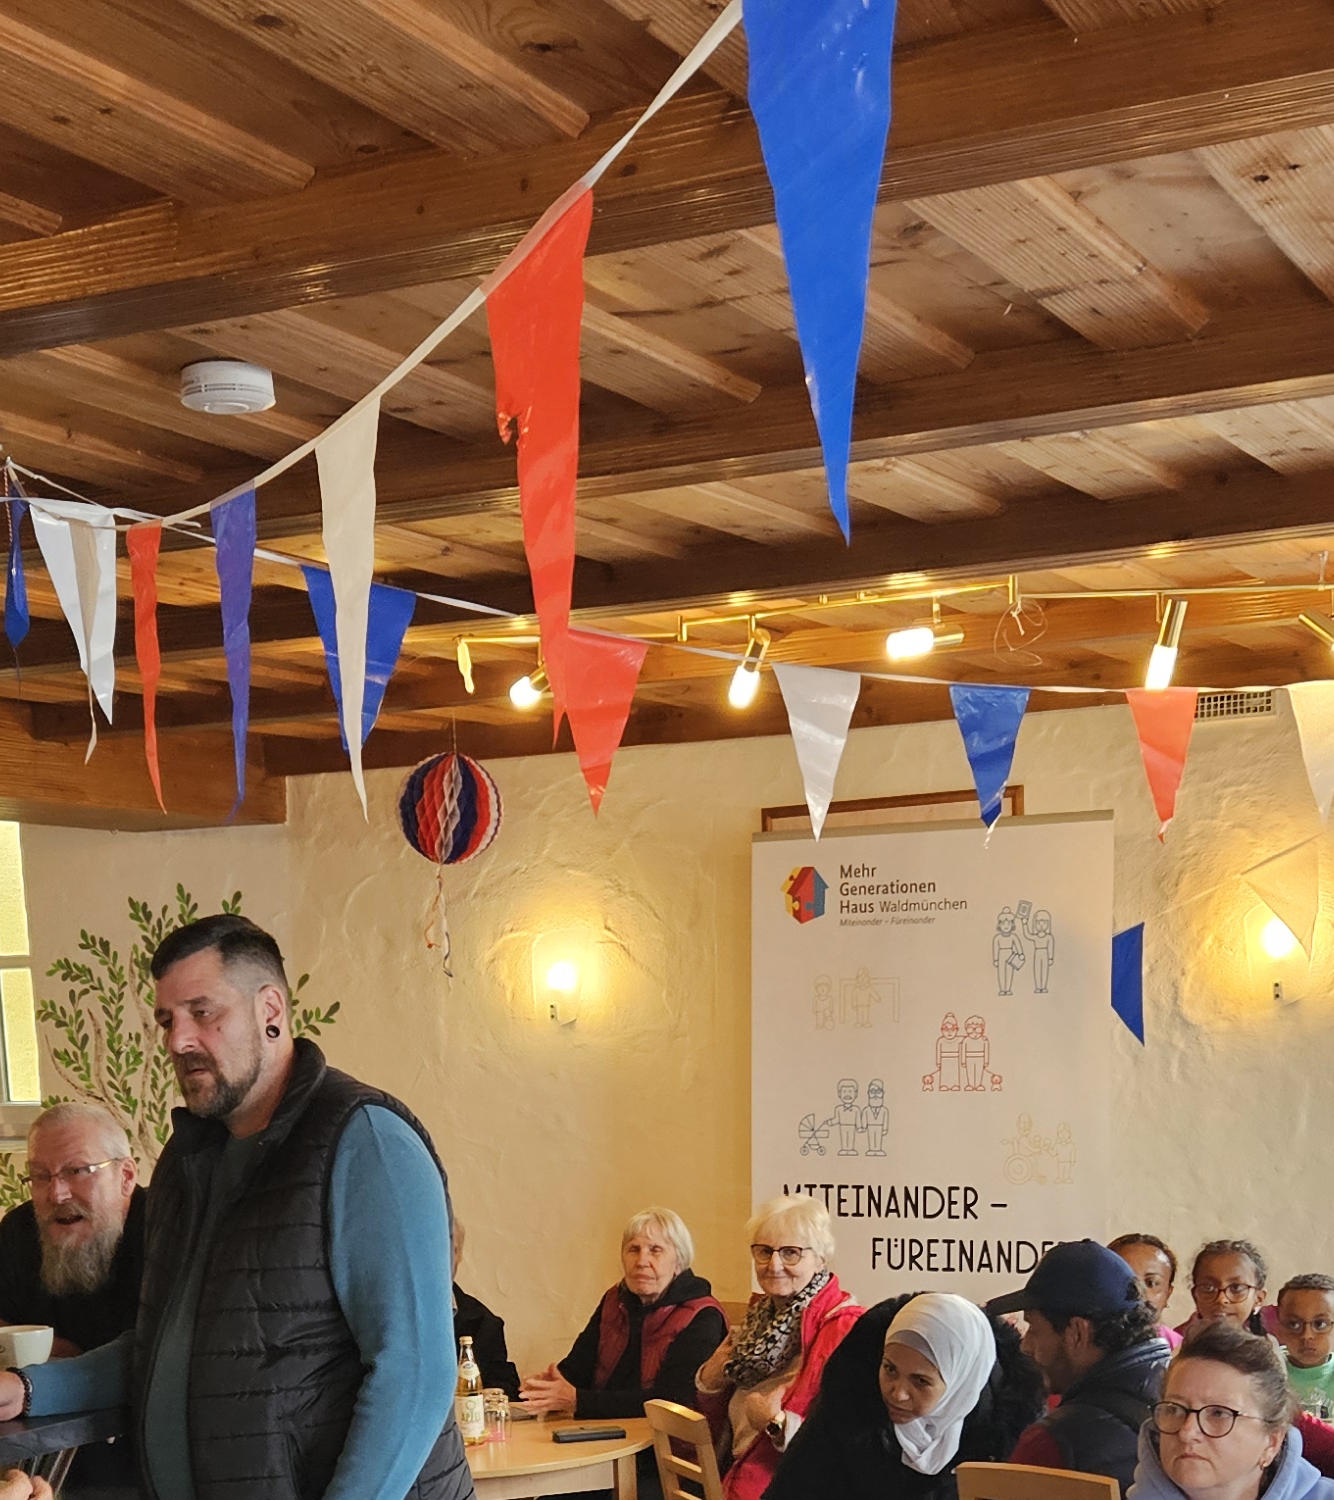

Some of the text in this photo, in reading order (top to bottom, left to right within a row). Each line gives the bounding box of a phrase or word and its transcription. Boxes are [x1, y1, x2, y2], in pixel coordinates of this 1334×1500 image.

[839, 863, 877, 879] Mehr
[839, 880, 936, 896] Generationen
[839, 898, 968, 914] Haus Waldmünchen
[839, 918, 883, 927] Miteinander
